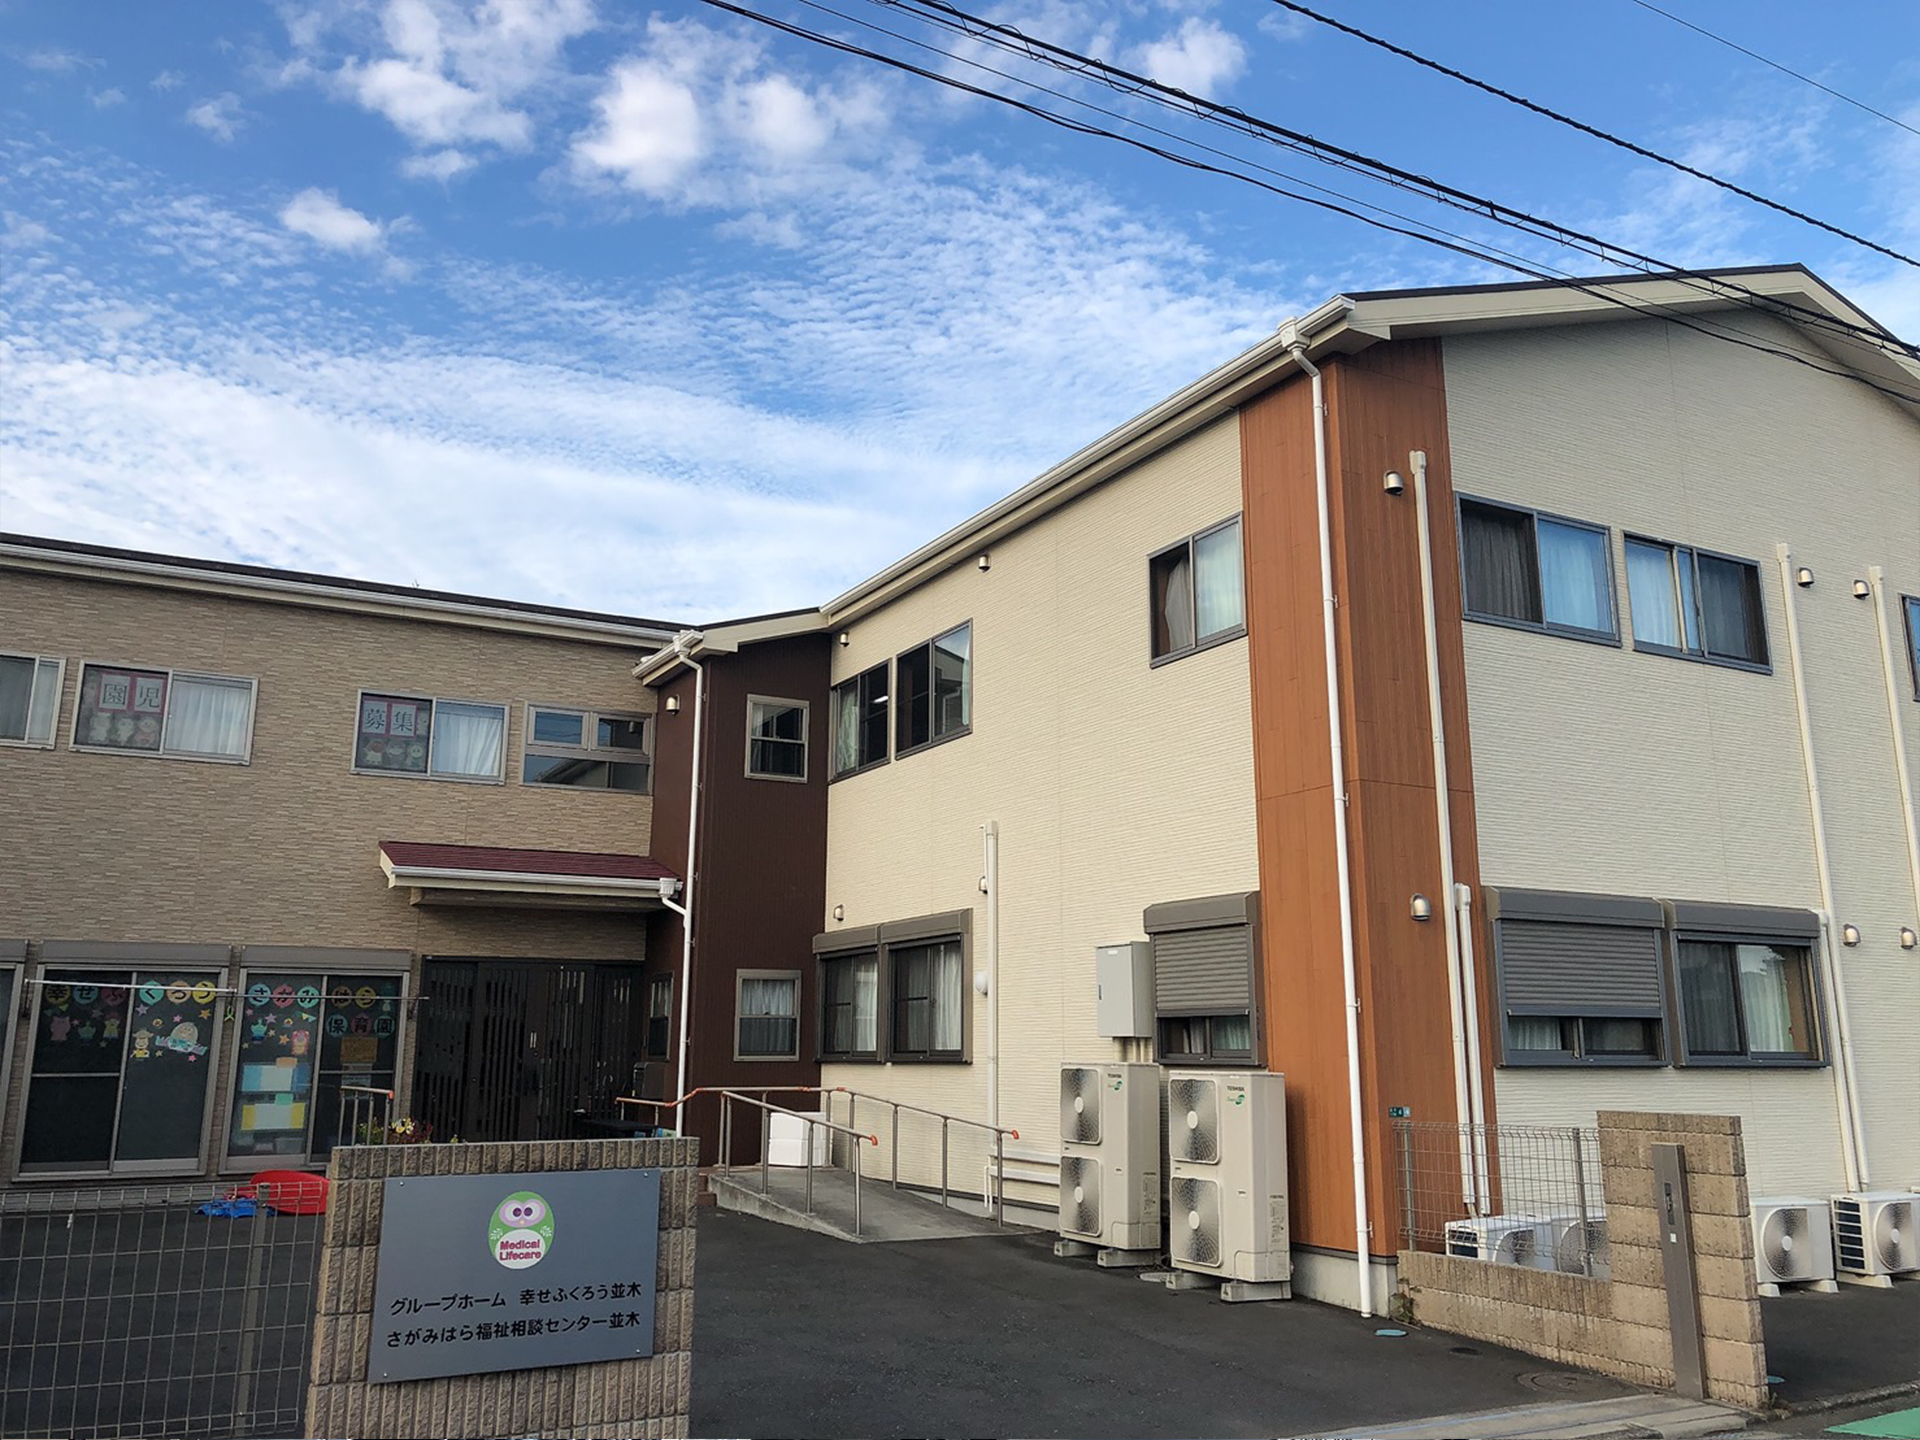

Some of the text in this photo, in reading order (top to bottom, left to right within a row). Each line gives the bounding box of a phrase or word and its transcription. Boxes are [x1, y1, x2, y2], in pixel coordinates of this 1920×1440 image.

[103, 682, 160, 708] 園児
[365, 709, 412, 732] 募集
[330, 1018, 392, 1033] 保育園
[499, 1239, 541, 1251] Medical
[499, 1250, 542, 1261] Lifecare
[390, 1282, 642, 1316] グループホーム 幸せふくろう並木
[386, 1312, 640, 1348] さがみはら福祉相談センター並木
